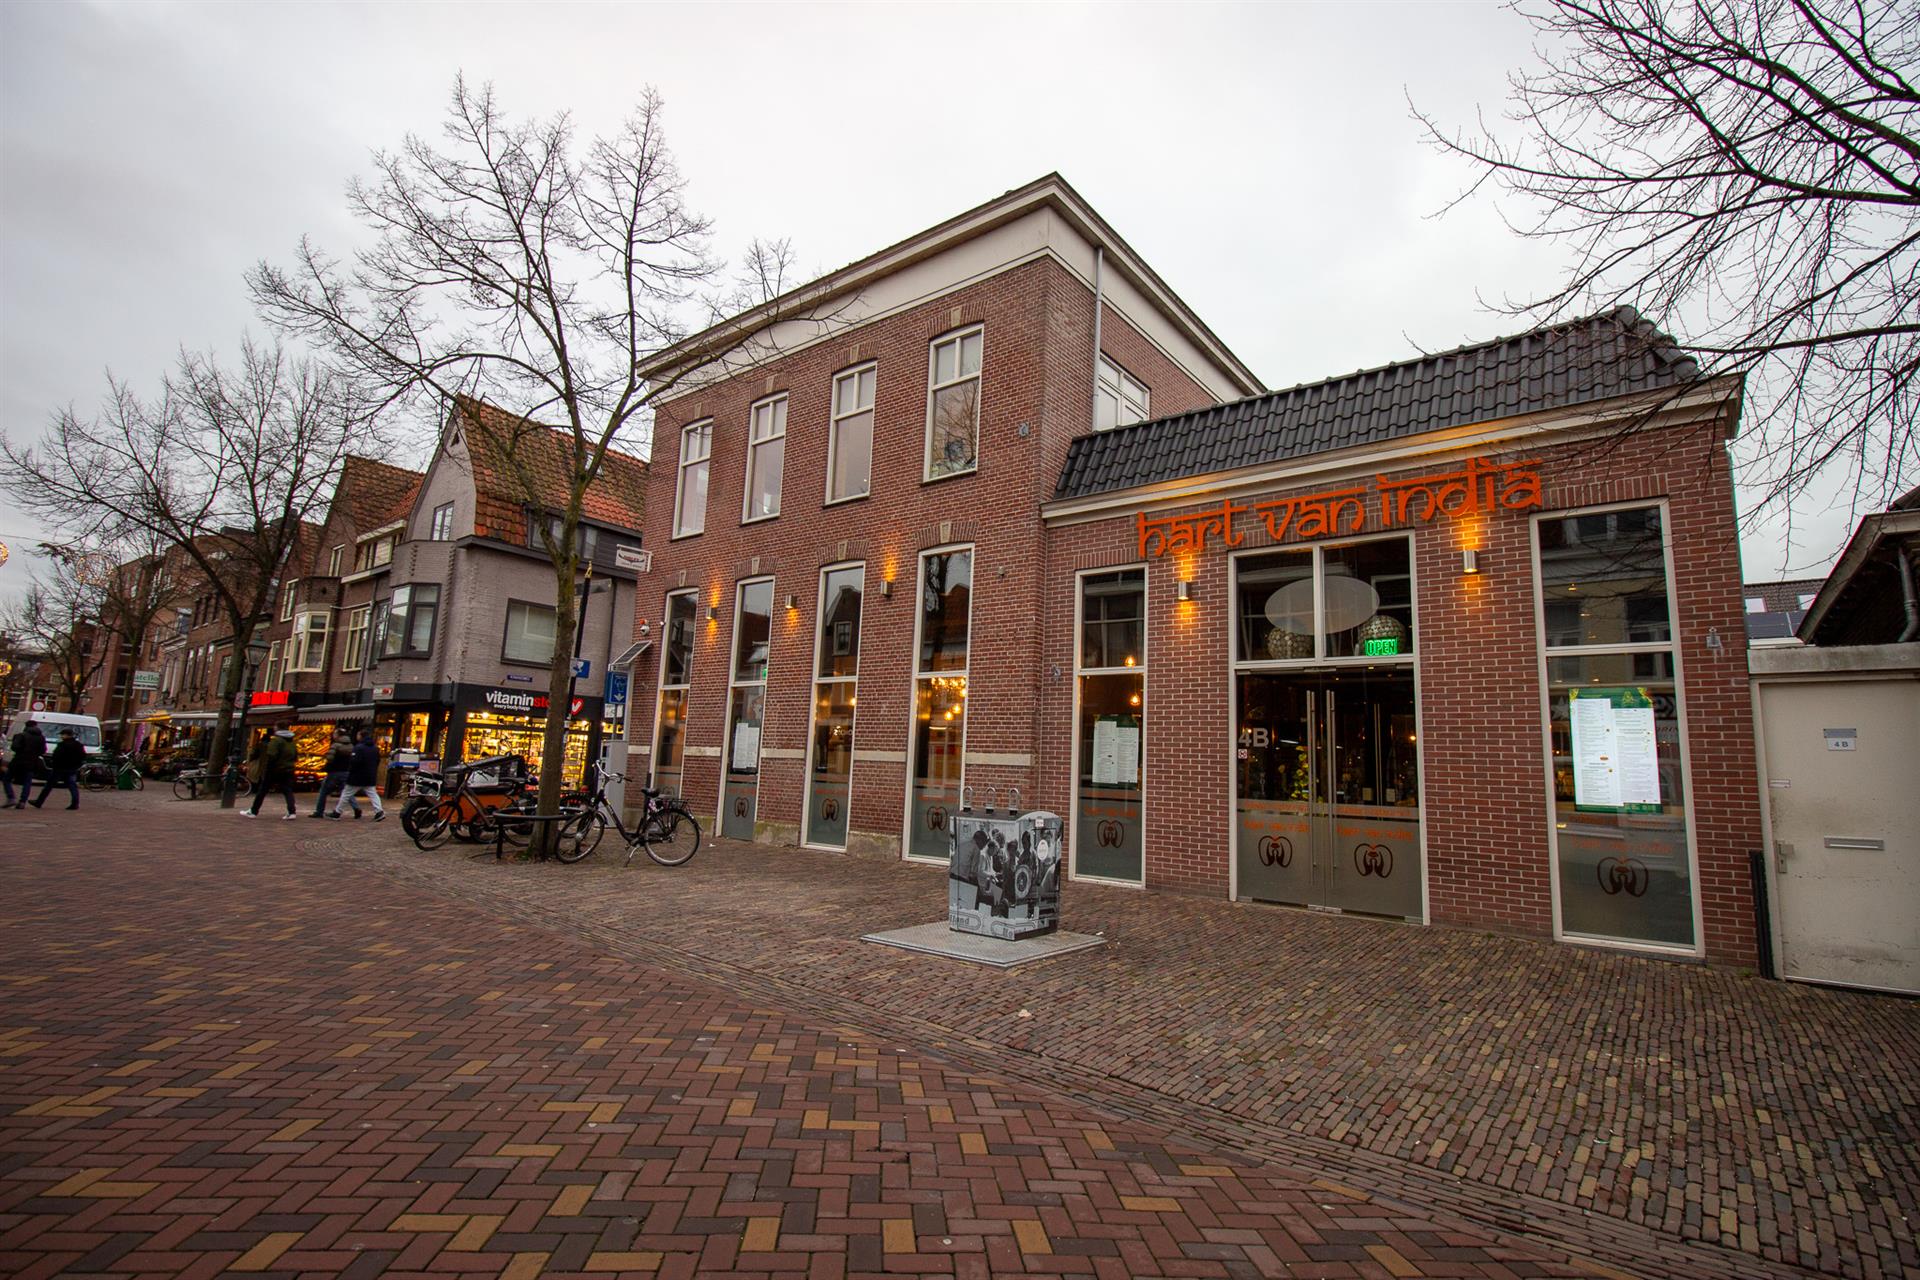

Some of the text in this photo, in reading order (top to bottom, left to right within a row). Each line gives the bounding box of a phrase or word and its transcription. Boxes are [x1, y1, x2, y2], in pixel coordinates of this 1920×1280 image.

[1137, 456, 1543, 558] hart van india
[1366, 639, 1397, 656] OPEN
[1238, 727, 1270, 748] 4B
